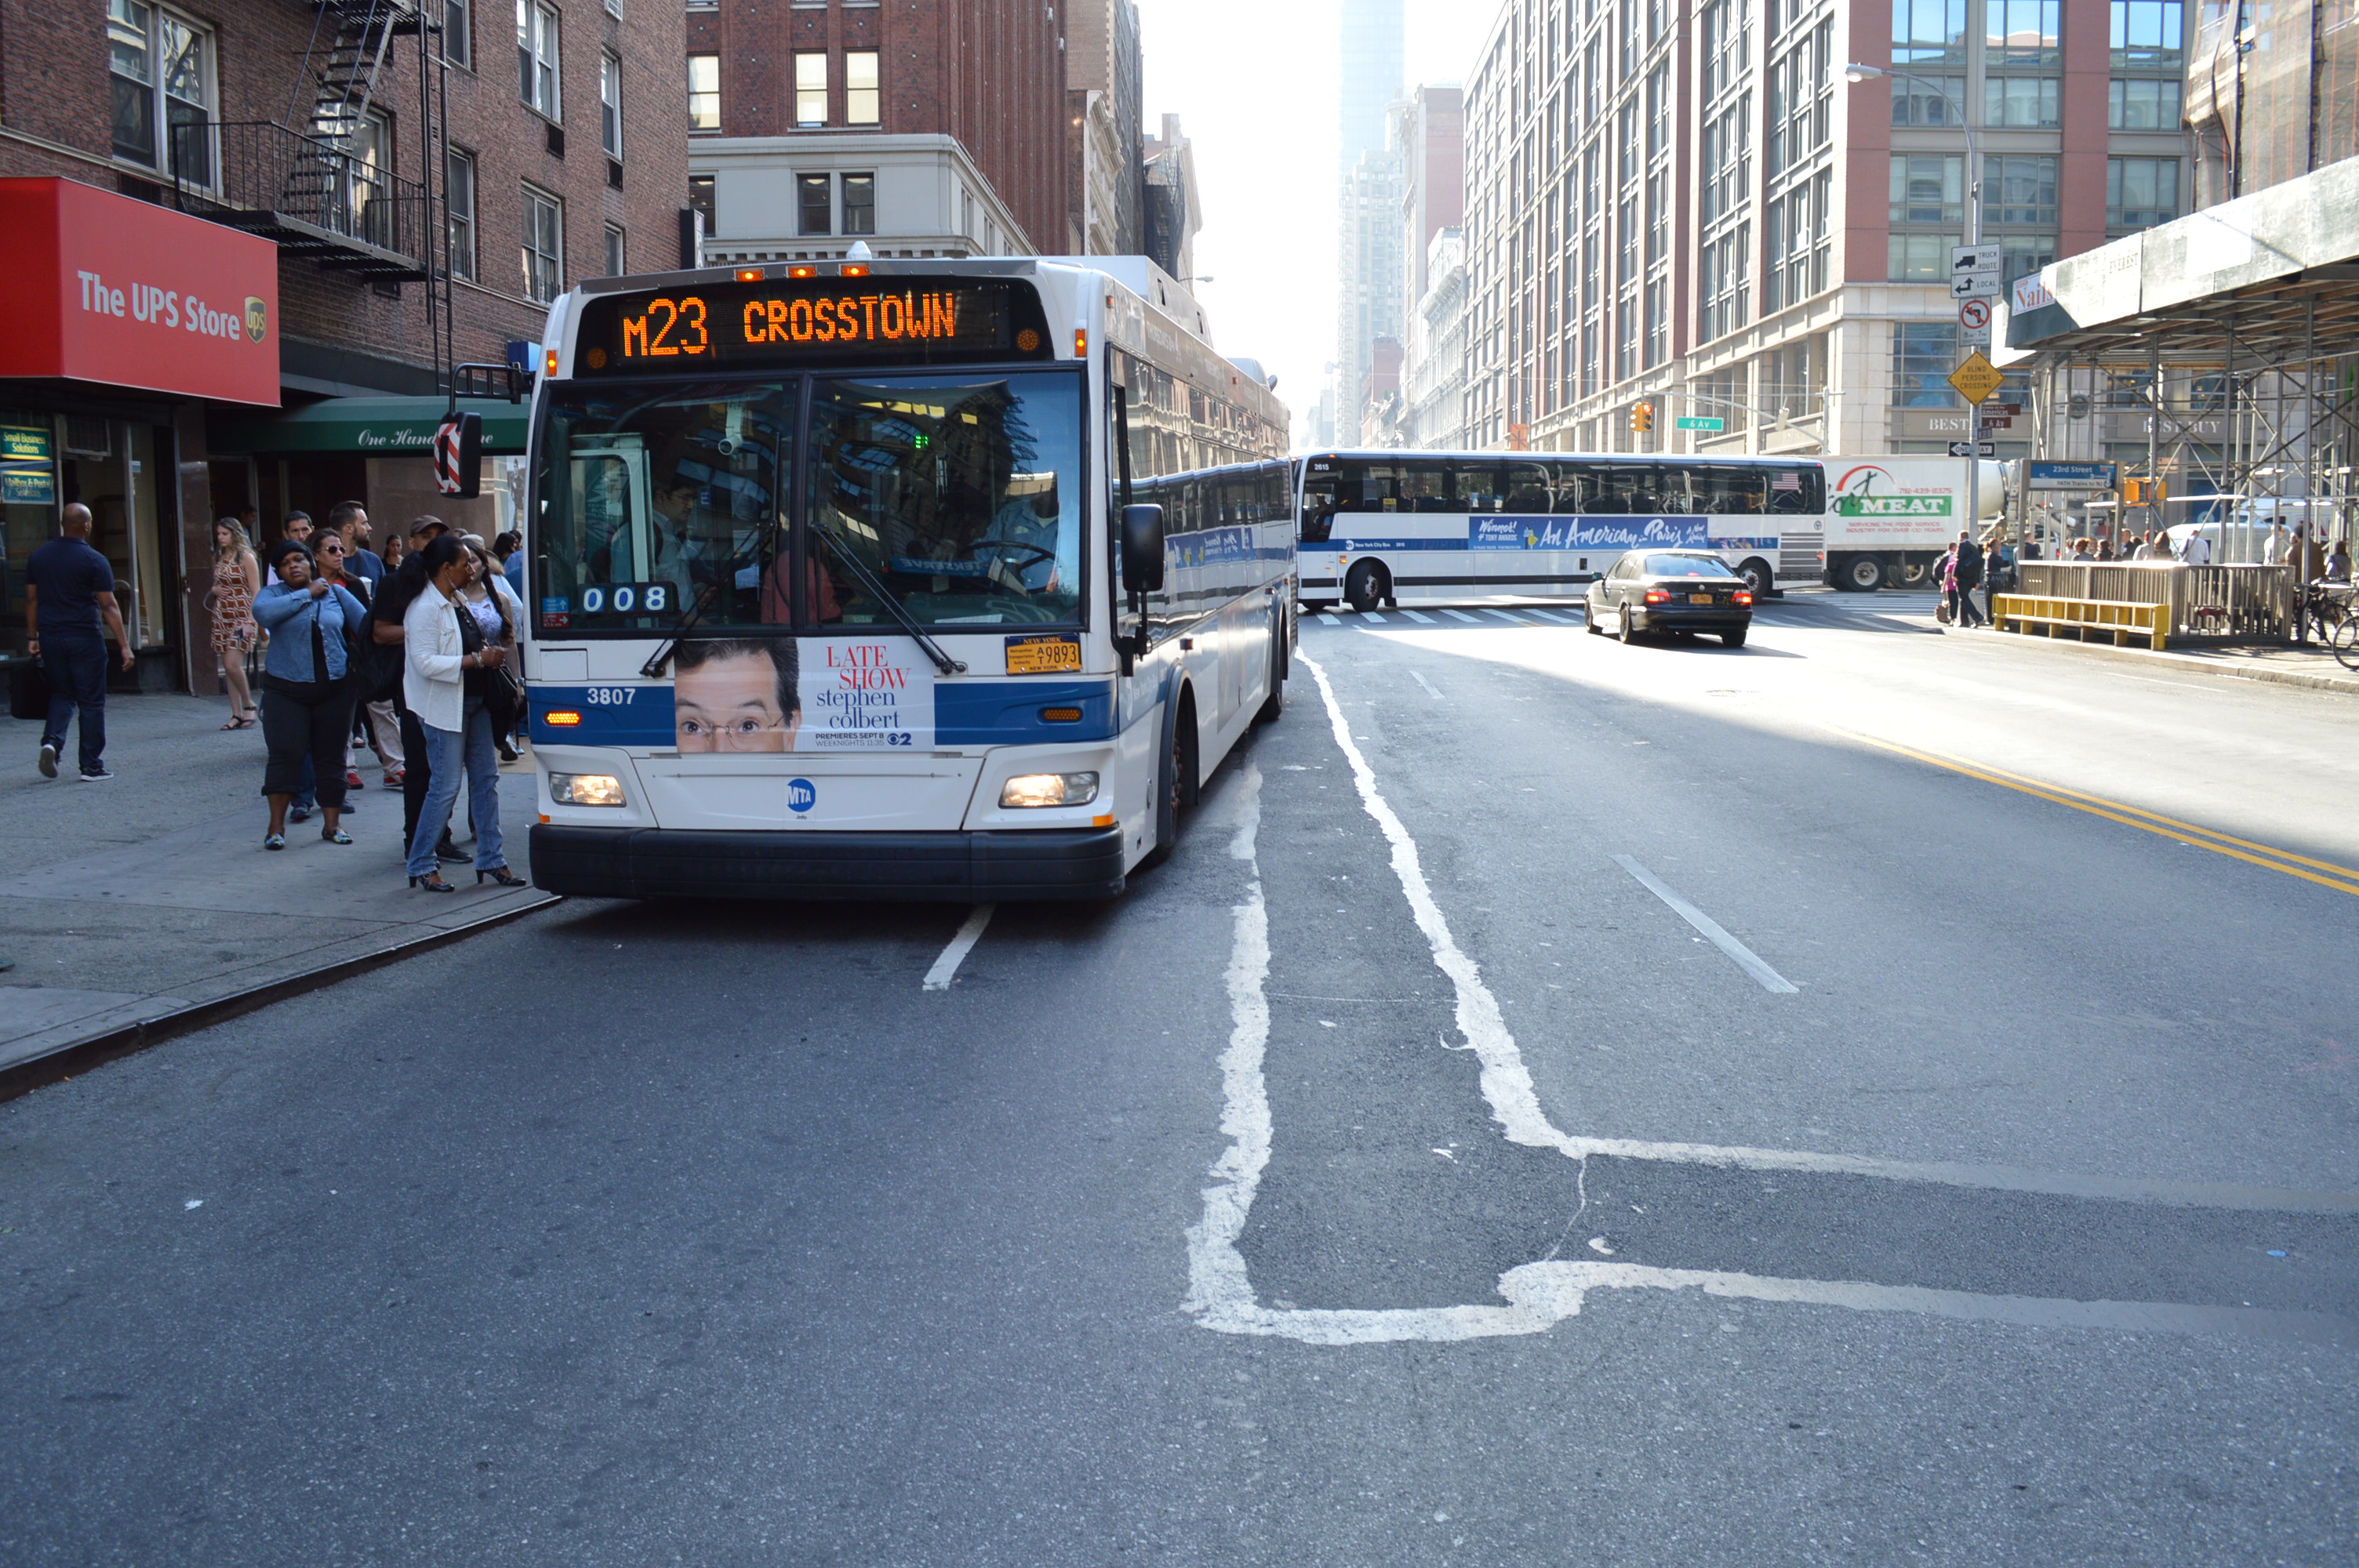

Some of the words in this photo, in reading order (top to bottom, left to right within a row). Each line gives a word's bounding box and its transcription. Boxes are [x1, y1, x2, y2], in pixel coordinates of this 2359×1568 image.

[78, 270, 125, 318] The
[132, 282, 180, 328] UPS
[185, 295, 240, 340] Store
[2016, 281, 2054, 311] Nails
[246, 310, 265, 337] ups
[623, 297, 708, 357] M23
[744, 292, 954, 342] CROSSTOWN
[1690, 419, 1696, 428] 6
[1697, 419, 1710, 428] Av
[1929, 418, 1969, 430] BEST
[2188, 421, 2221, 434] BUY
[4, 431, 20, 442] Small
[21, 432, 46, 445] Business
[358, 429, 387, 446] One
[12, 442, 40, 454] Solutions
[28, 477, 34, 486] &
[1859, 499, 1944, 514] MEAT
[1479, 518, 1518, 533] Winner!
[1539, 520, 1562, 547] An
[1565, 517, 1640, 549] American
[1644, 519, 1683, 549] Paris
[826, 645, 889, 667] LATE
[1045, 645, 1077, 664] 9893
[839, 667, 912, 690] SHOW
[587, 688, 636, 705] 3807
[816, 684, 897, 715] stephen
[829, 706, 901, 729] colbert
[899, 732, 912, 746] 2
[786, 784, 812, 805] MTA
